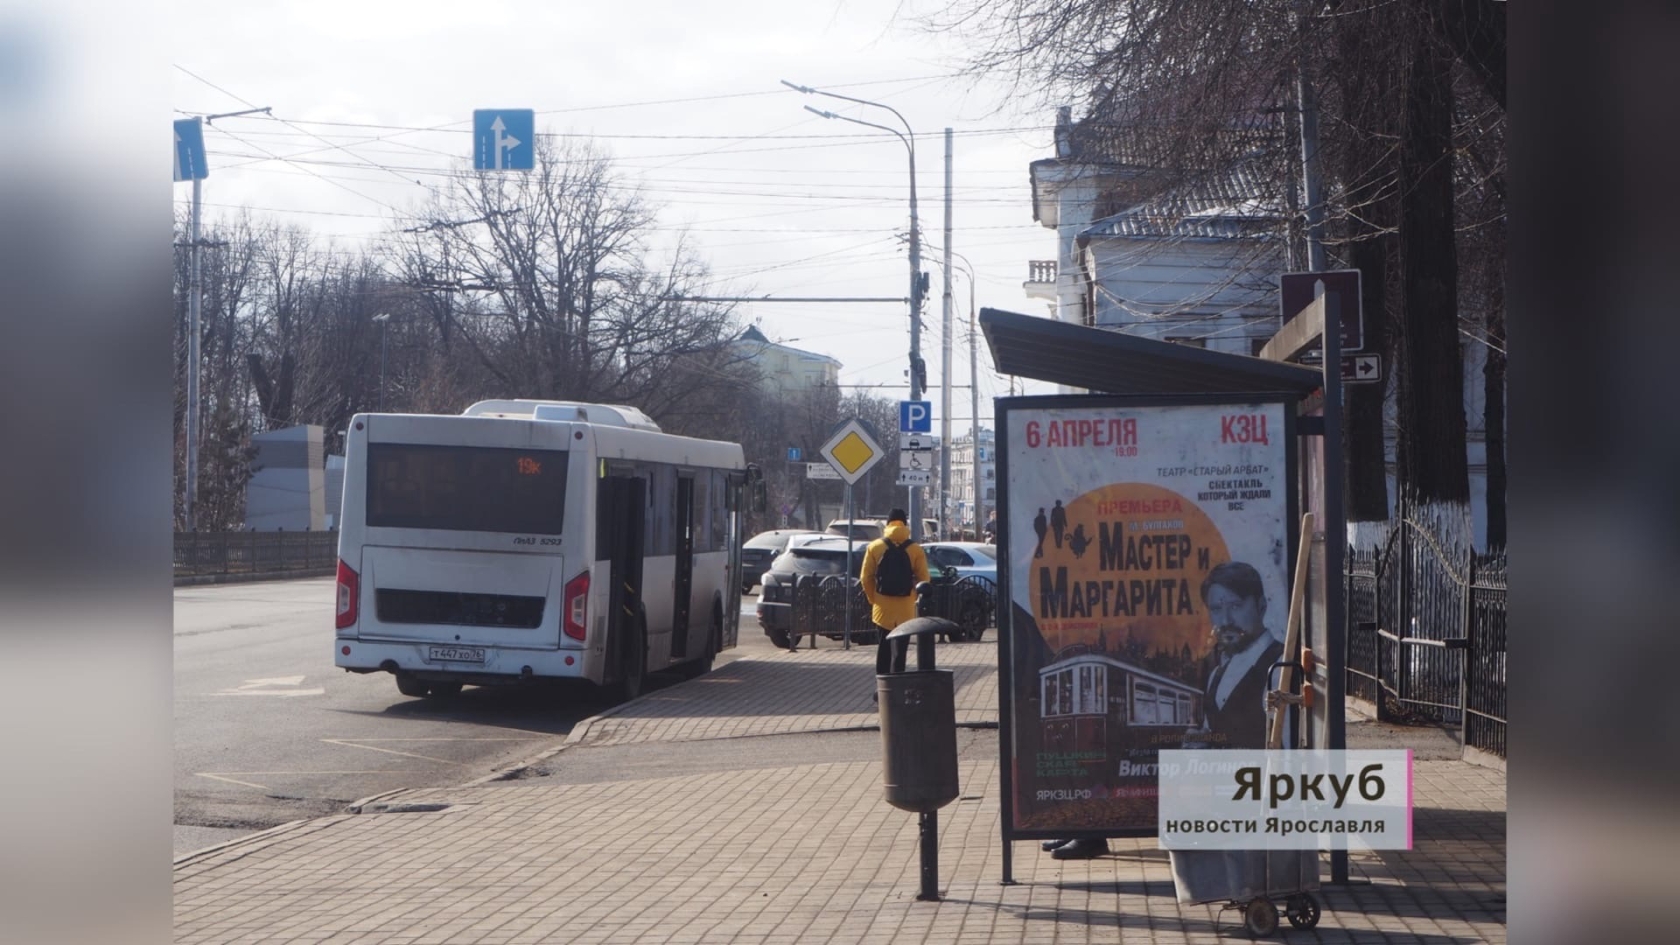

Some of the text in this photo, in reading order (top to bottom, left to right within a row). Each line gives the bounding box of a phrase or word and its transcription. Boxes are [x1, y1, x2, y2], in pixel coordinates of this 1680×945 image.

[1026, 418, 1137, 448] 6 АПРЕЛЯ
[1221, 415, 1268, 445] КЗЦ
[1157, 467, 1186, 477] ТЕАТР
[1234, 464, 1269, 475] АРБАТ»
[1208, 479, 1263, 490] СПЕКТАКЛЬ
[1198, 489, 1271, 501] КОТОРЫЙ ЖДАЛИ
[1098, 499, 1183, 515] ПРЕМЬЕРА
[1228, 502, 1244, 511] ВСЕ
[1118, 759, 1181, 778] Виктор
[1036, 788, 1092, 801] ЯРКЗЦ.РФ
